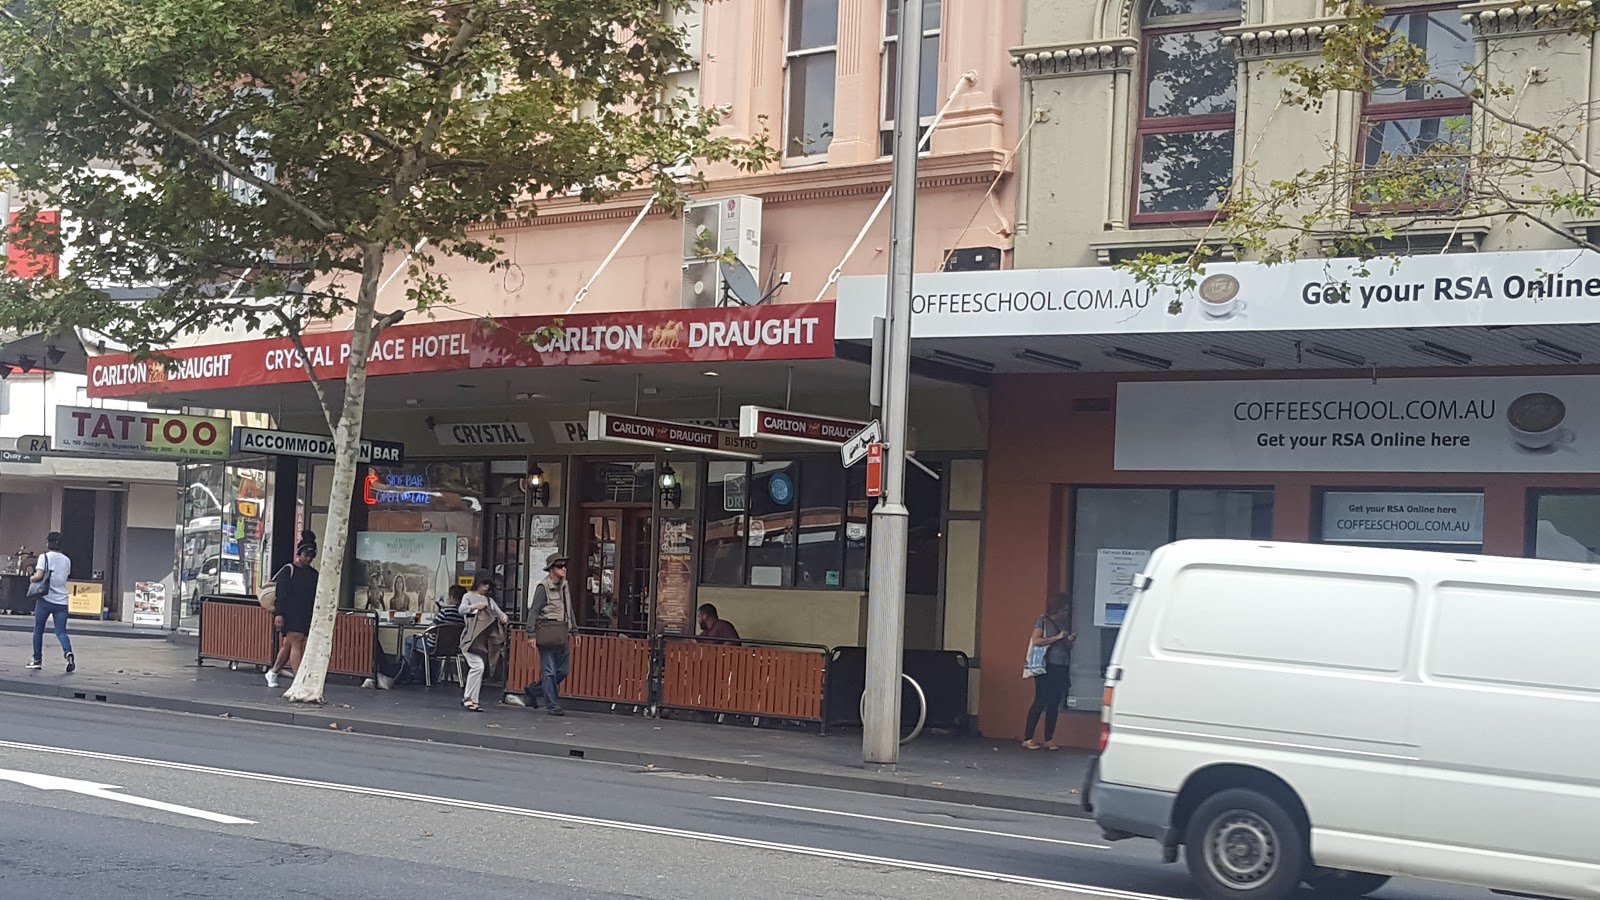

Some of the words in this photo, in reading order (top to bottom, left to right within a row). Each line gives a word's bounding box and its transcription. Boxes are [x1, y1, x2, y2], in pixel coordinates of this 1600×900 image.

[911, 288, 1150, 315] OFFEESCHOOL.COM.AU
[1359, 282, 1425, 309] your
[1433, 276, 1494, 301] RSA
[1502, 273, 1600, 300] Online
[532, 324, 642, 353] CARLTON
[688, 317, 819, 348] DRAUGHT
[265, 346, 334, 371] CRYSTAL
[340, 338, 405, 364] PACE
[411, 333, 470, 359] HOTEL
[92, 362, 147, 387] CARLTON
[167, 353, 232, 381] DRAUGHT
[1233, 399, 1496, 421] COFFEESCHOOL.COM.AU
[72, 411, 217, 446] TATTOO
[452, 424, 526, 444] CRYSTAL
[612, 420, 655, 437] CARLTON
[669, 429, 713, 445] DRAUGHT
[725, 436, 758, 450] BISTRO
[764, 416, 807, 433] CARLTON
[821, 425, 861, 439] DRAUG
[244, 433, 370, 458] ACCOMMODAN
[373, 446, 400, 461] BAR
[1256, 433, 1285, 447] Get
[1289, 434, 1327, 450] your
[1331, 433, 1365, 447] RSA
[1370, 432, 1425, 447] Online
[1430, 432, 1470, 447] here
[386, 474, 404, 486] SIDE
[405, 474, 423, 487] BAR
[411, 491, 431, 504] LATE
[727, 496, 745, 508] DRY
[1348, 504, 1363, 513] Get
[1366, 505, 1385, 515] your
[1387, 505, 1405, 513] RSA
[1406, 505, 1435, 514] Online
[1437, 505, 1457, 514] here
[1336, 519, 1470, 532] COFFEESCHOOL.COM.AU
